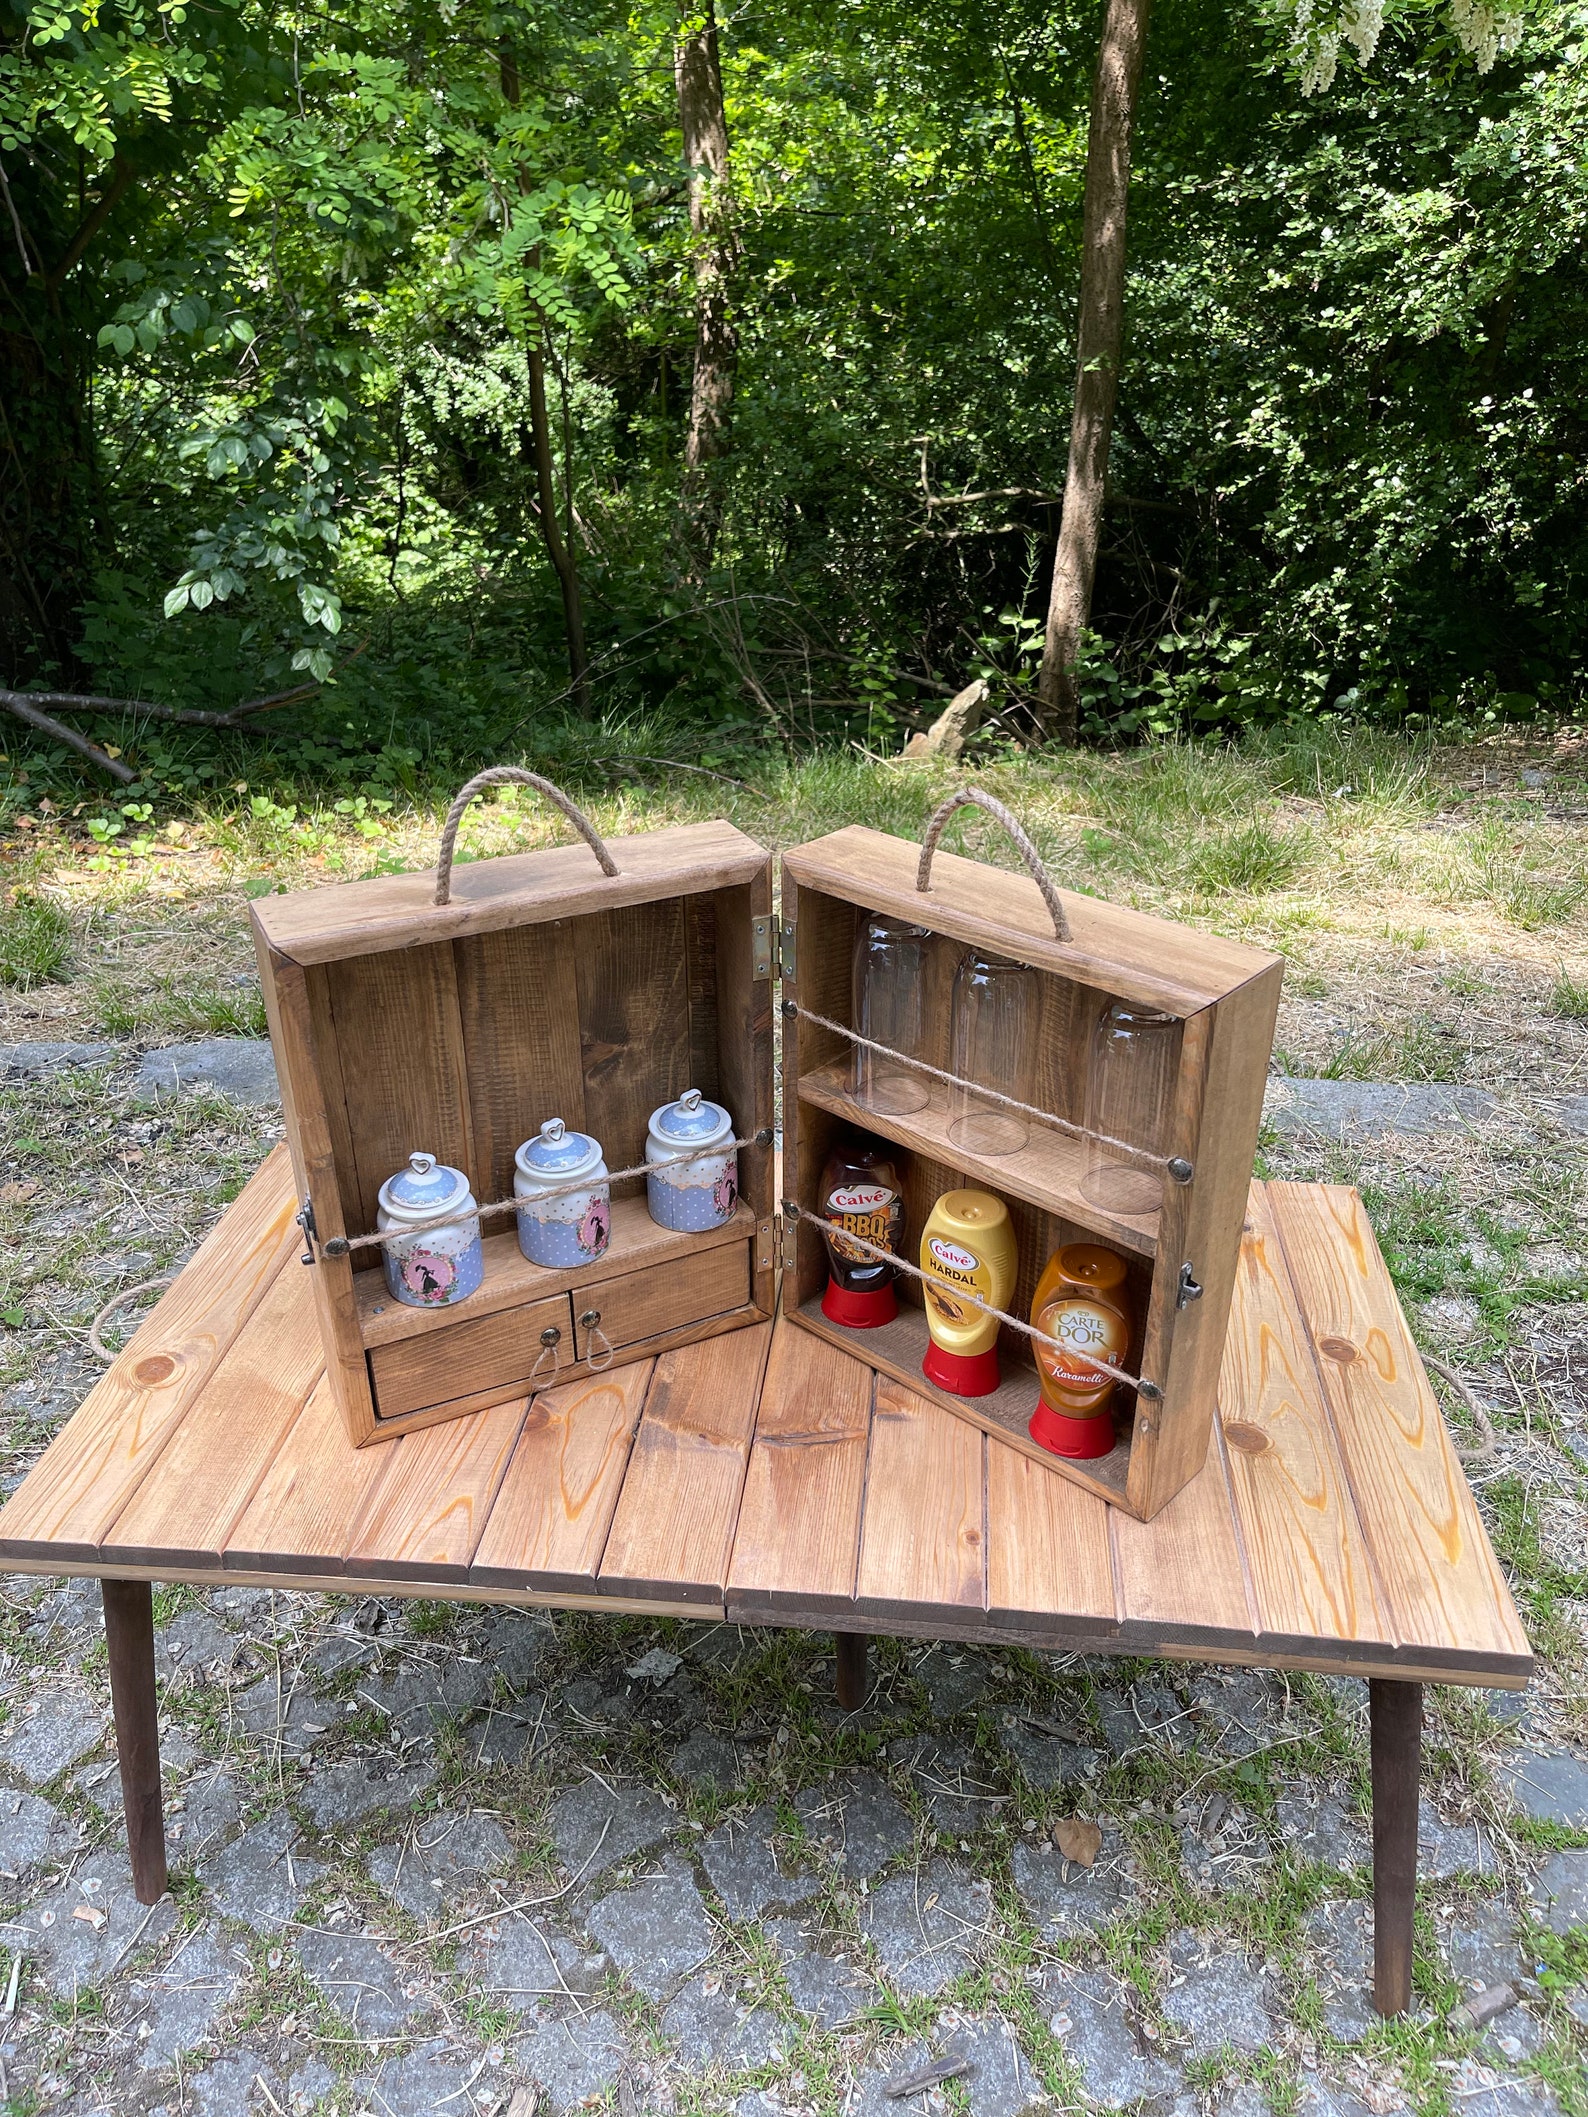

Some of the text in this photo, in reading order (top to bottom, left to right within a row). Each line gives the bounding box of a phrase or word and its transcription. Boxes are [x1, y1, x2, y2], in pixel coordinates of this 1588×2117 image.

[835, 1190, 884, 1206] Calvé
[843, 1213, 886, 1239] BBQ
[934, 1245, 970, 1266] Calvé
[929, 1257, 977, 1286] HARDAL
[1057, 1312, 1105, 1330] CARTE
[1057, 1324, 1111, 1348] D'OR
[1051, 1365, 1104, 1384] Karamelli
